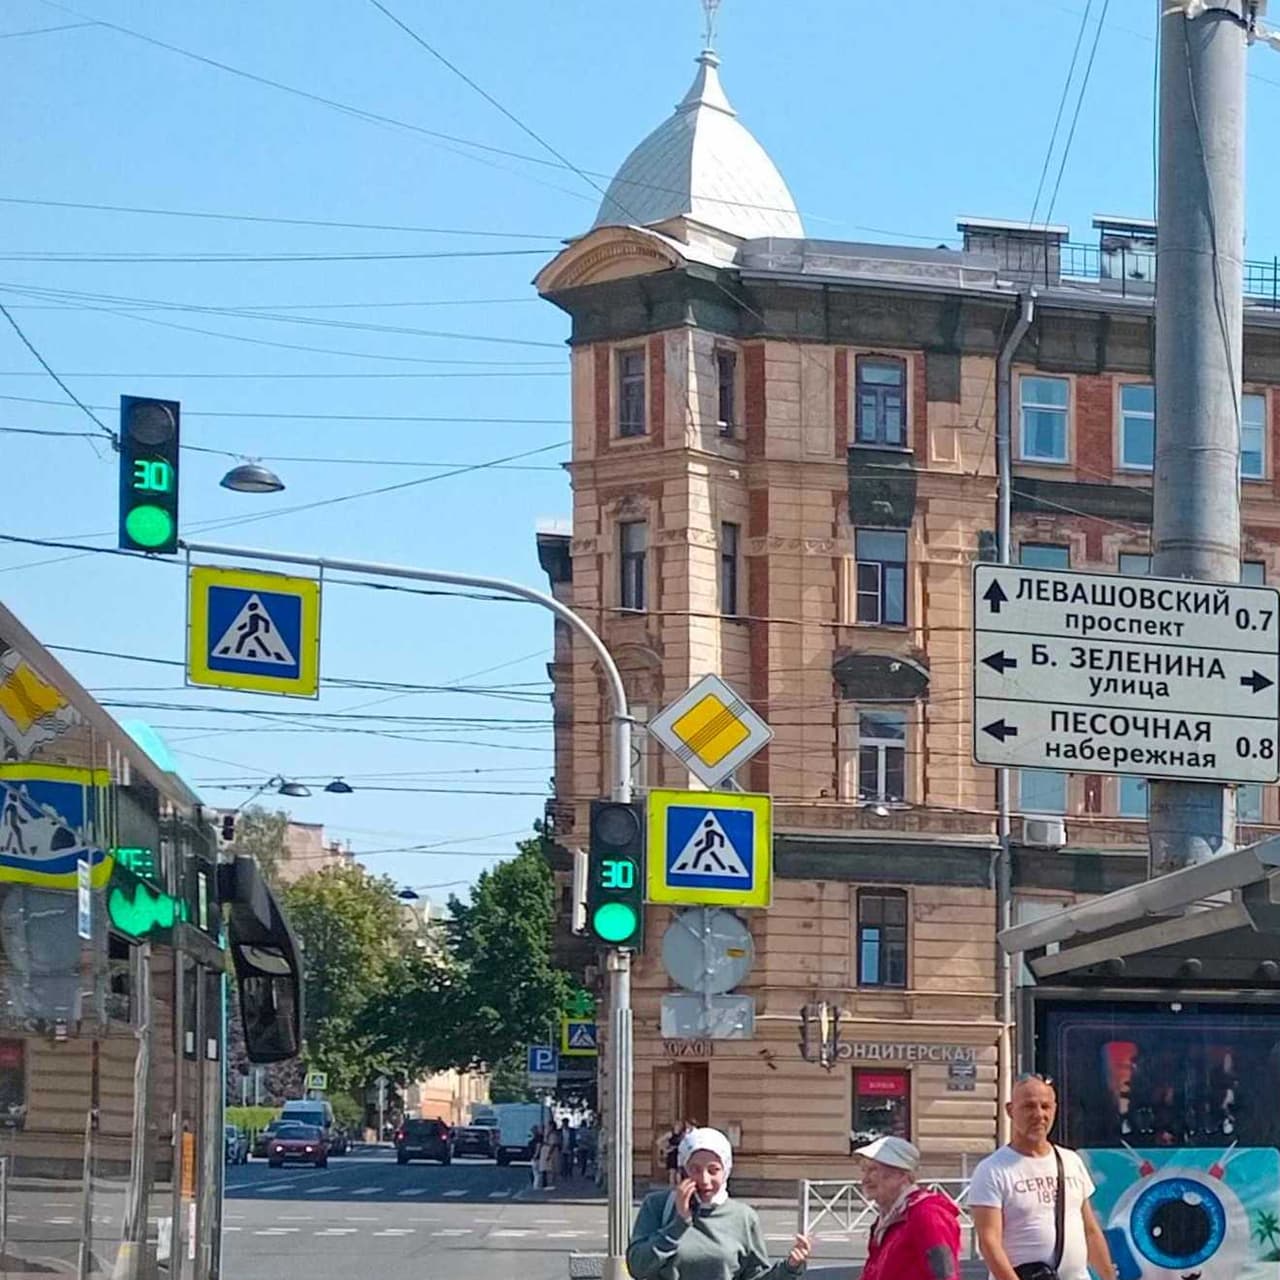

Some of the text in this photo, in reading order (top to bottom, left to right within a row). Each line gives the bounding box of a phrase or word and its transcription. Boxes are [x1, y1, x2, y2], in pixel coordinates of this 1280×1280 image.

[133, 460, 168, 491] 30
[1016, 577, 1230, 616] ЛЕВАШОВСКИЙ
[1065, 613, 1185, 638] проспект
[1235, 608, 1274, 631] 0.7
[1031, 643, 1226, 680] Б. ЗЕЛЕНИНА
[1089, 677, 1170, 700] улица
[1050, 710, 1212, 743] ПЕСОЧНАЯ
[1045, 739, 1217, 769] набережная
[1235, 737, 1274, 760] 0.8
[602, 860, 633, 889] 30
